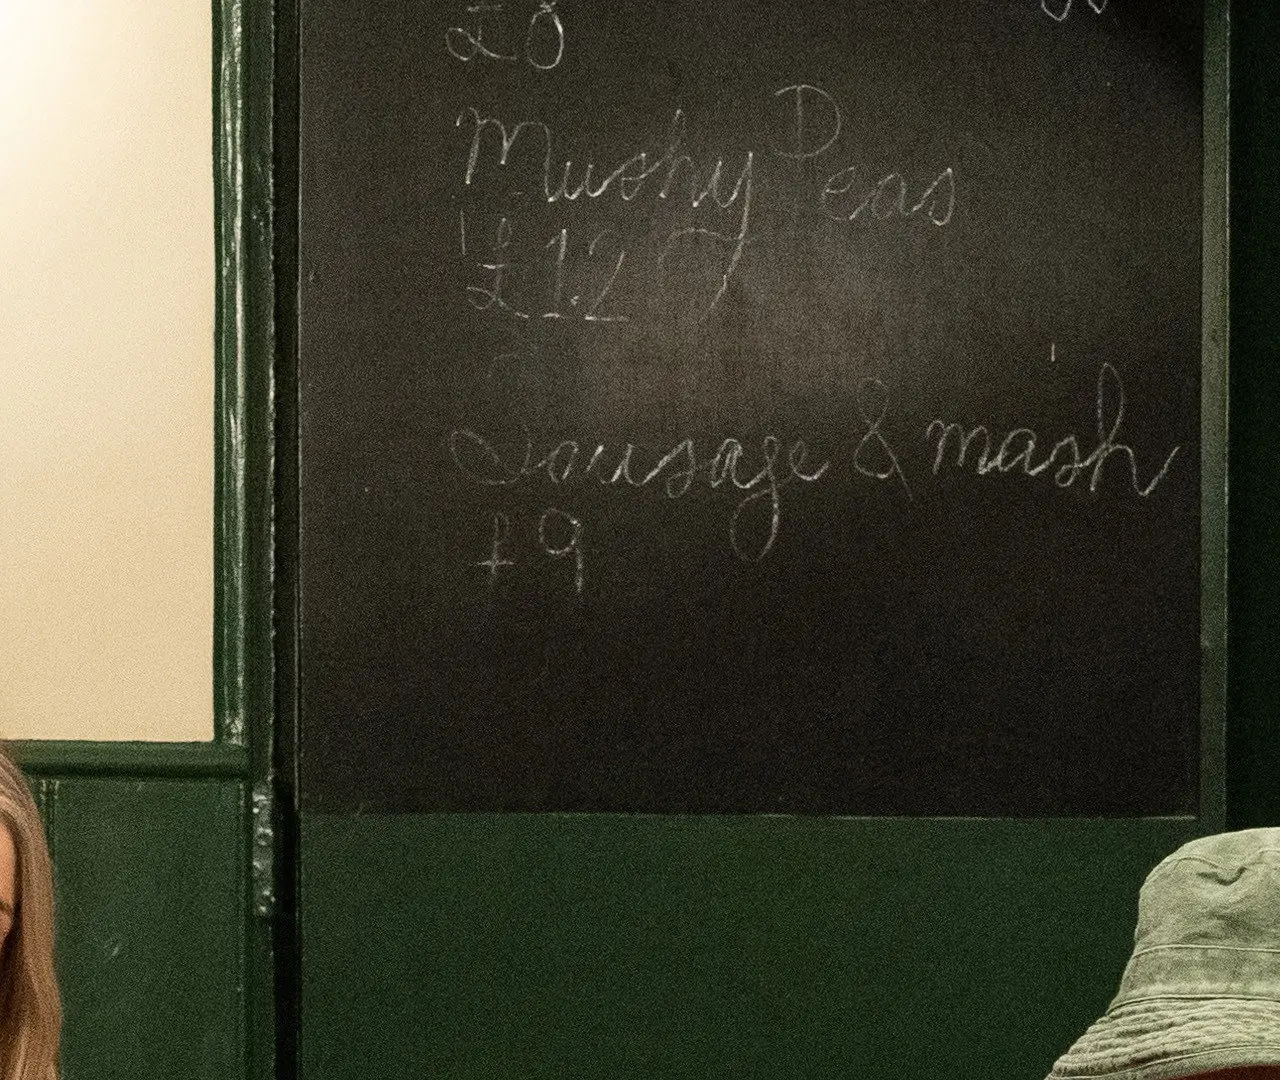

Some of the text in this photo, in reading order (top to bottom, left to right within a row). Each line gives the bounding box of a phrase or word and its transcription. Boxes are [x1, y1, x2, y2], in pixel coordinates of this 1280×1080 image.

[770, 84, 956, 228] Peas
[449, 363, 1181, 563] Sausage & mash
